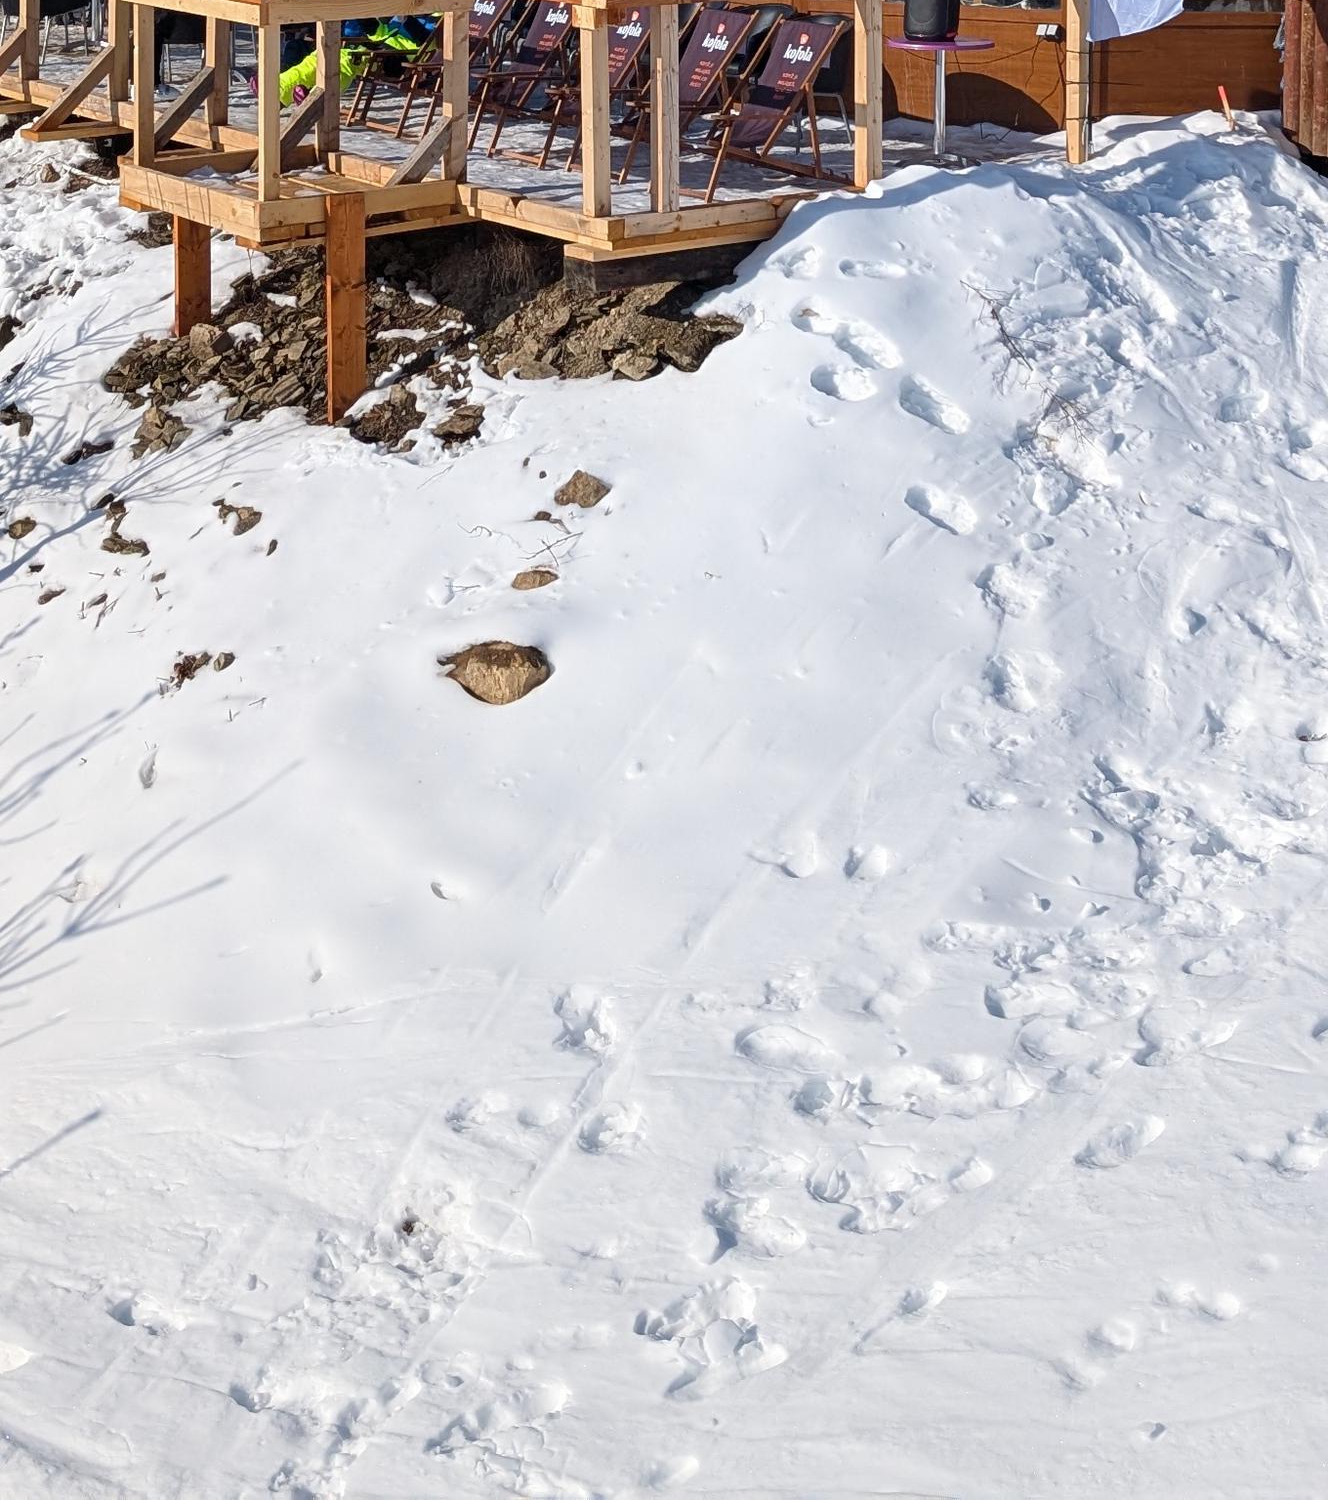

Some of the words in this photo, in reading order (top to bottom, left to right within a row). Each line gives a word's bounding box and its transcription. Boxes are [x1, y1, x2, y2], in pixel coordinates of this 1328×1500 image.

[544, 8, 569, 26] kofola
[701, 33, 730, 52] kofola
[783, 43, 815, 64] kofola
